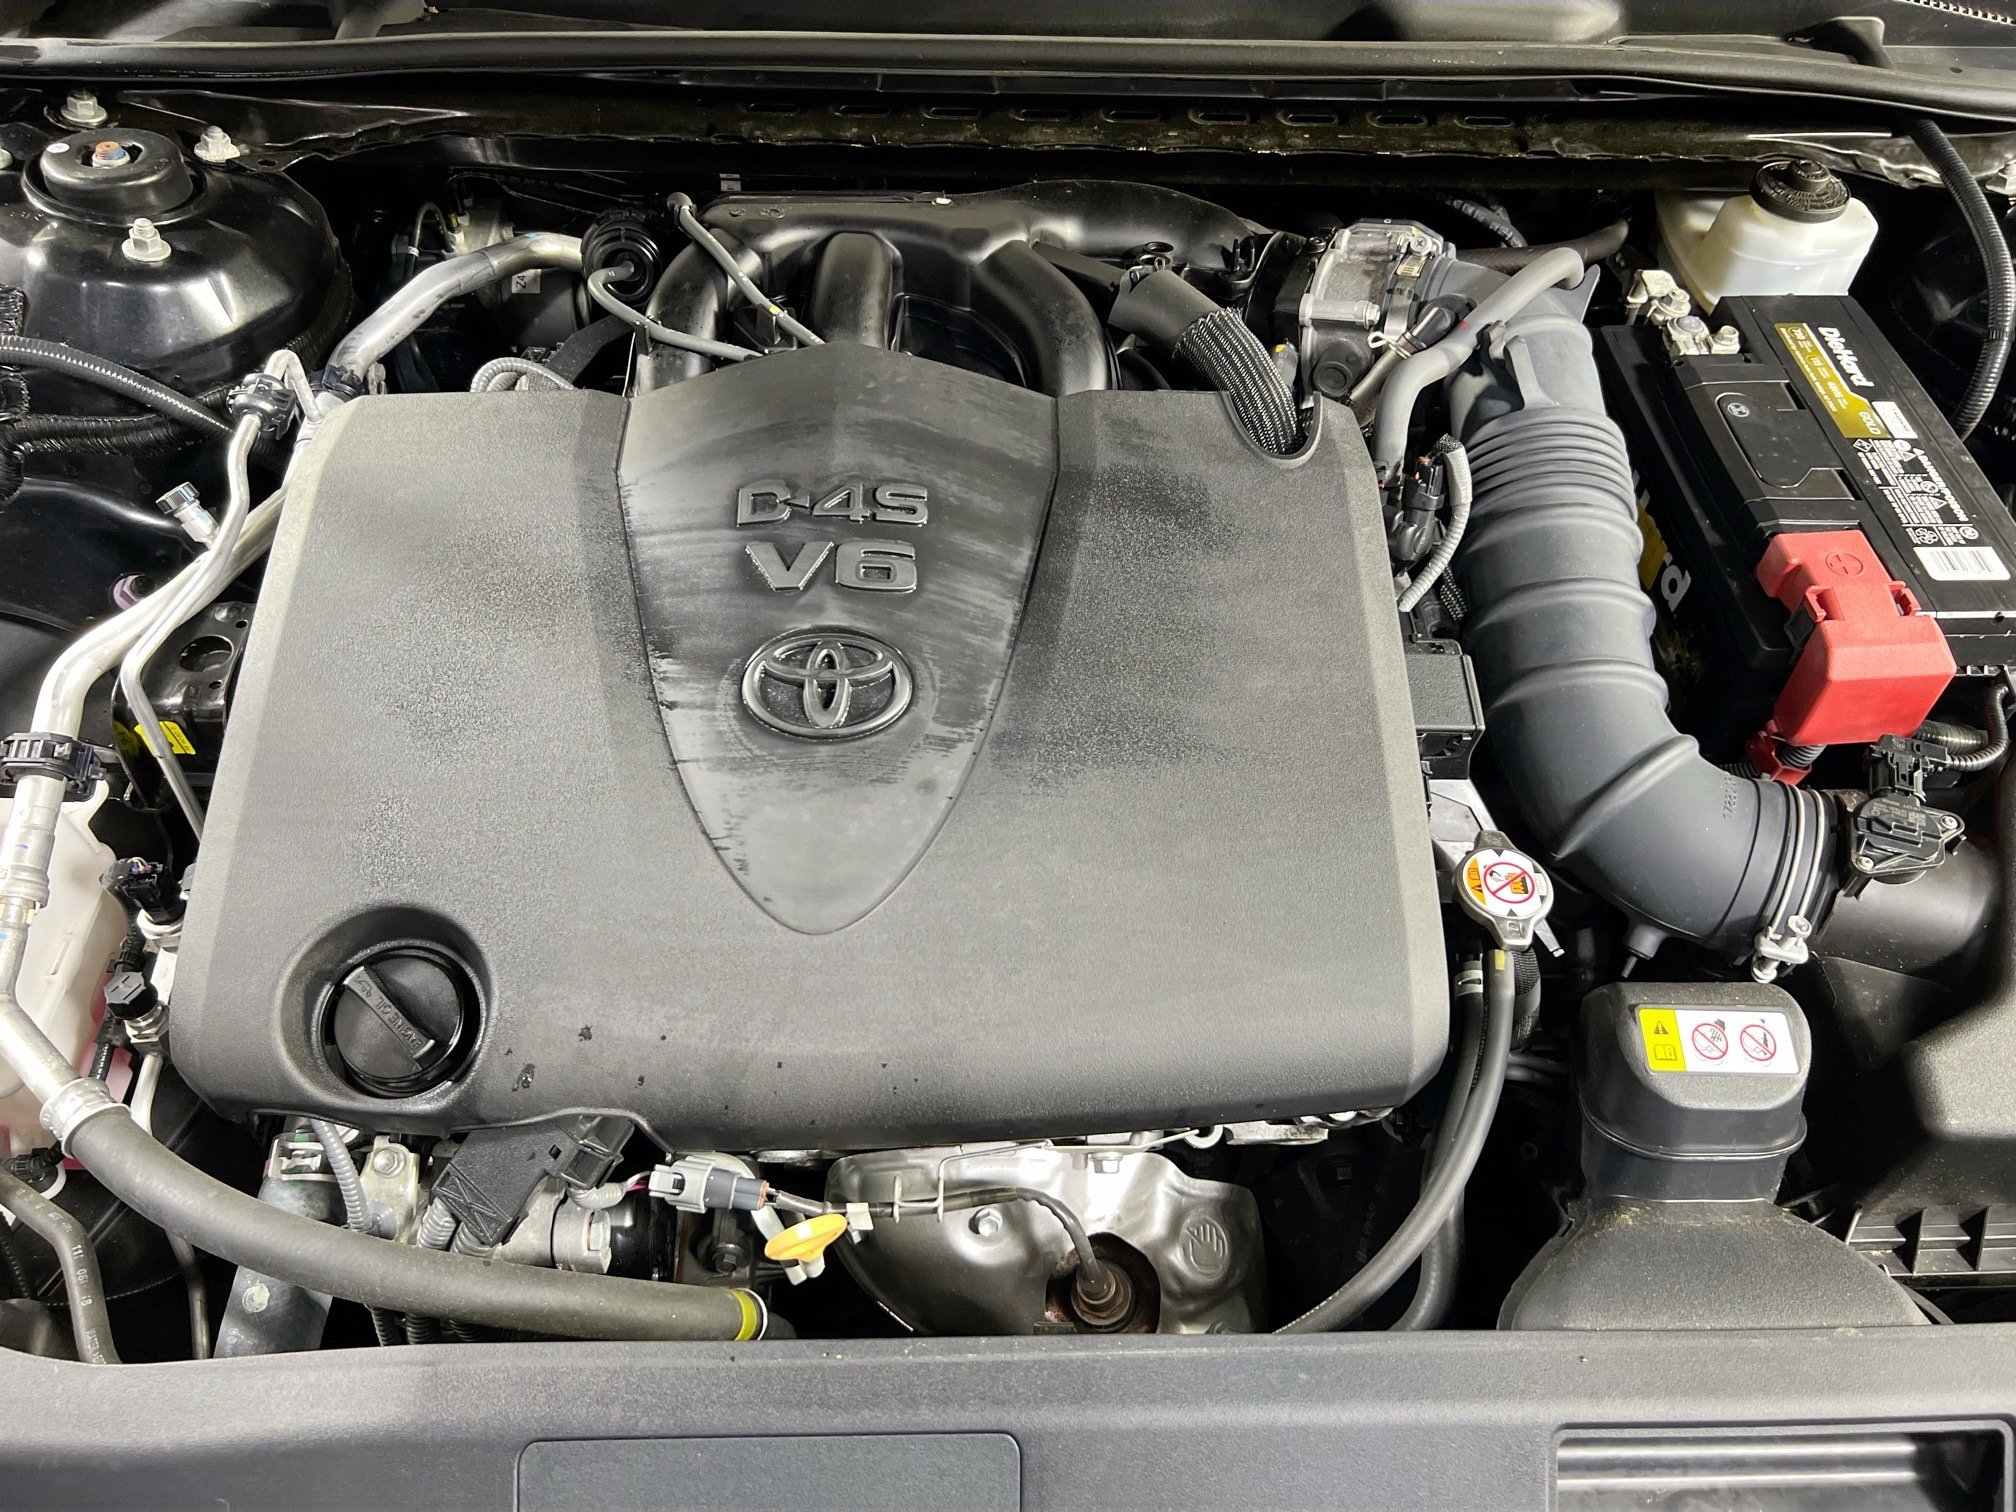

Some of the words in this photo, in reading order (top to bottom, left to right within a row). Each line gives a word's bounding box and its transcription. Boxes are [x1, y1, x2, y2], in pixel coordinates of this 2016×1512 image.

[1818, 327, 1875, 387] DieHard
[1858, 411, 1881, 435] GOLD
[745, 540, 918, 593] V6
[375, 996, 392, 1015] OIL
[388, 1012, 423, 1049] ENGINE
